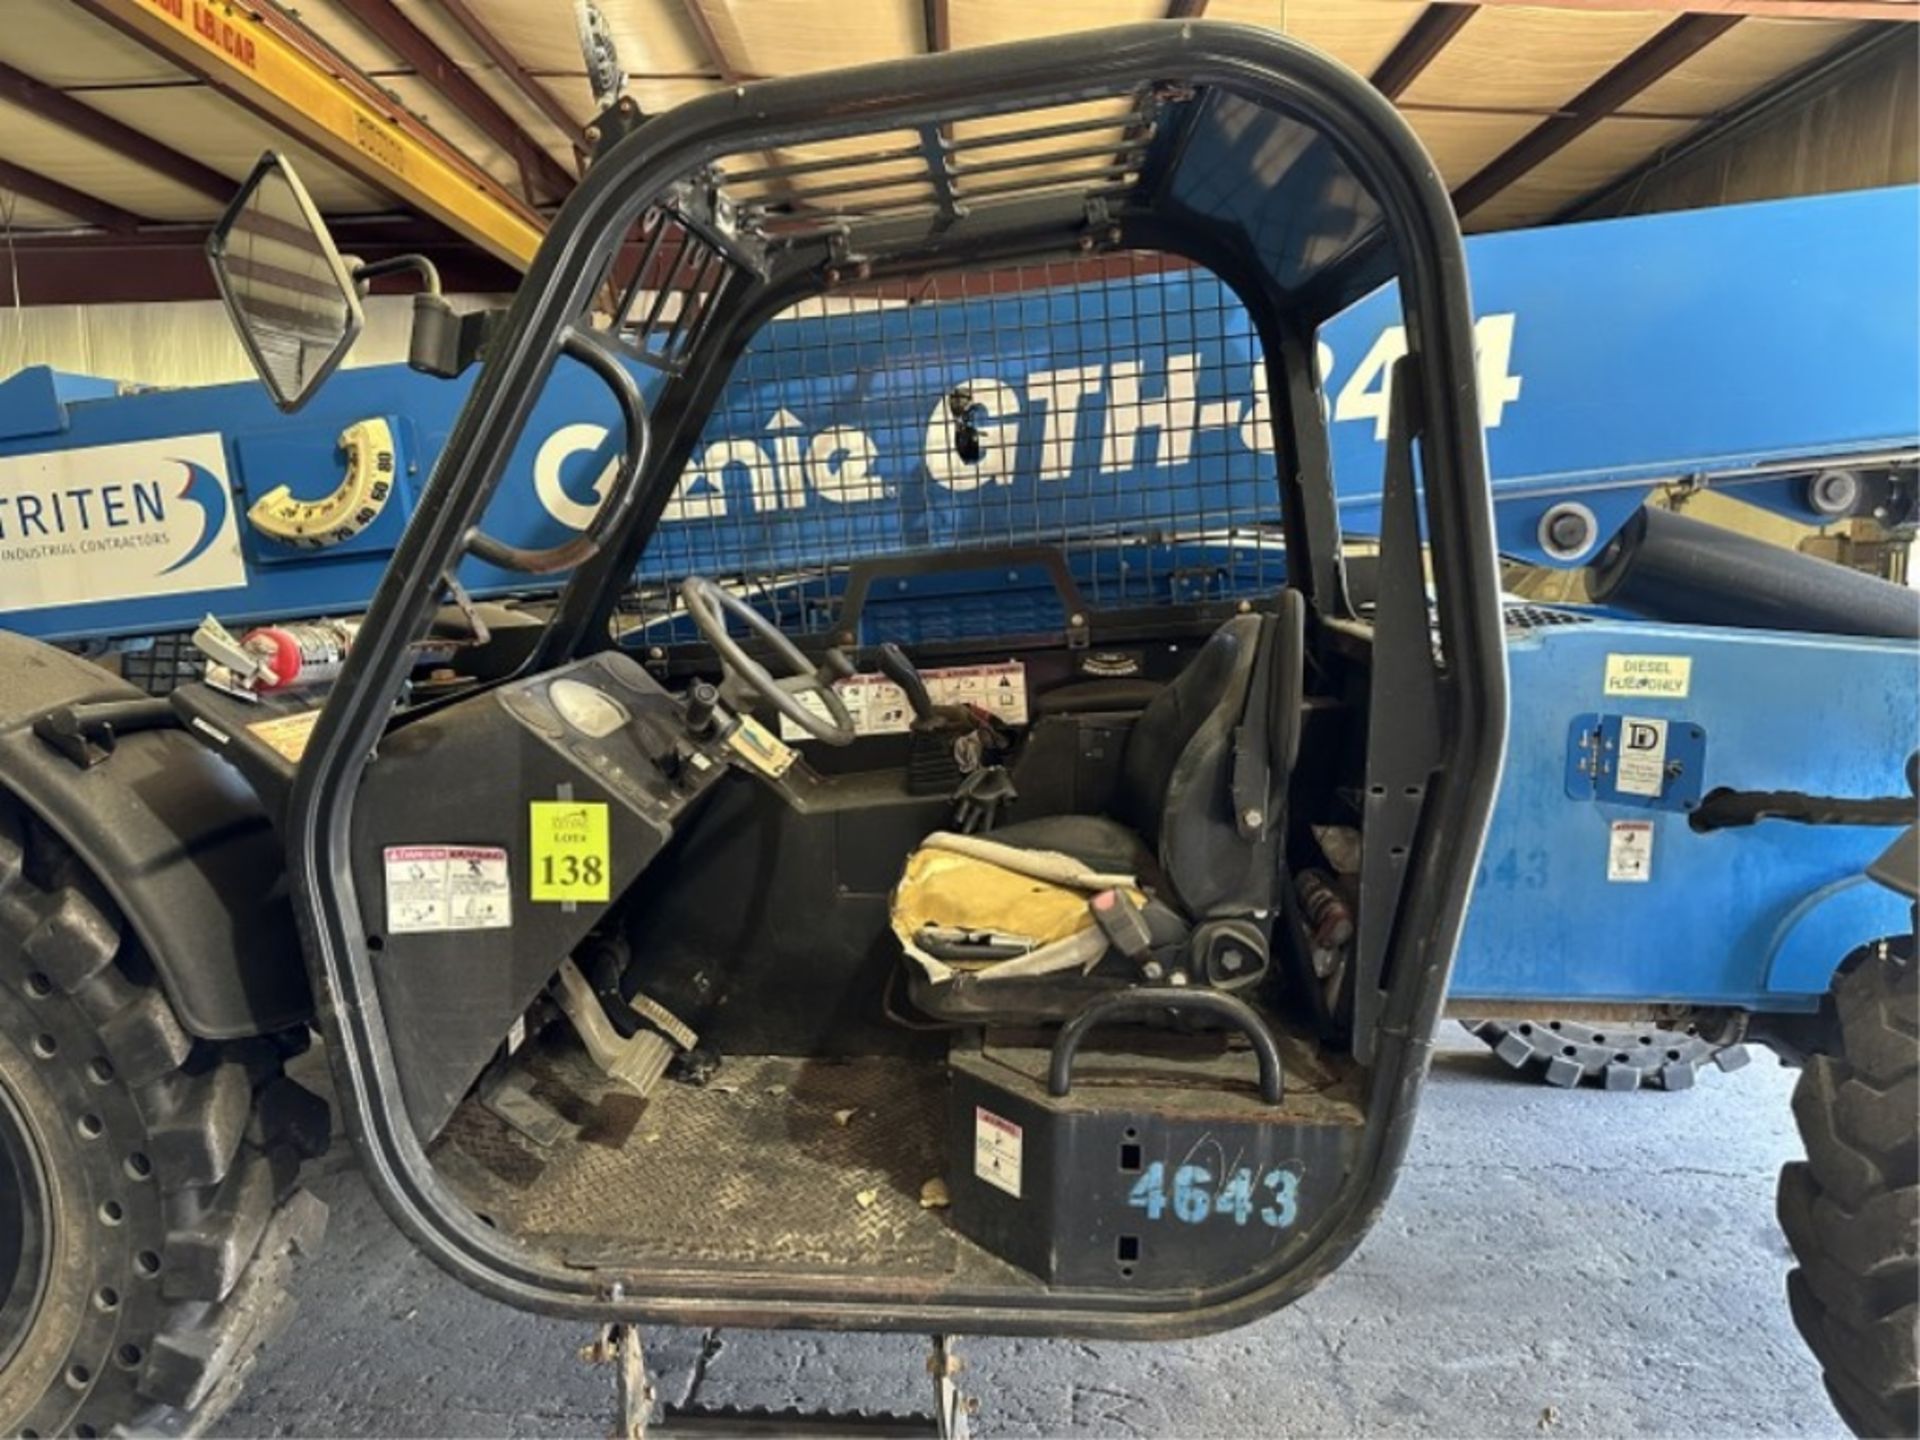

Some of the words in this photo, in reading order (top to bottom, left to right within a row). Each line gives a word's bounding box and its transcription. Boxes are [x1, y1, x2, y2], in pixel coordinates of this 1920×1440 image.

[377, 451, 392, 472] 80
[80, 532, 170, 554] CONTRACTORS
[1623, 660, 1671, 674] DIESEL
[1627, 723, 1659, 750] D
[541, 855, 603, 886] 138
[1128, 1161, 1298, 1228] 4643
